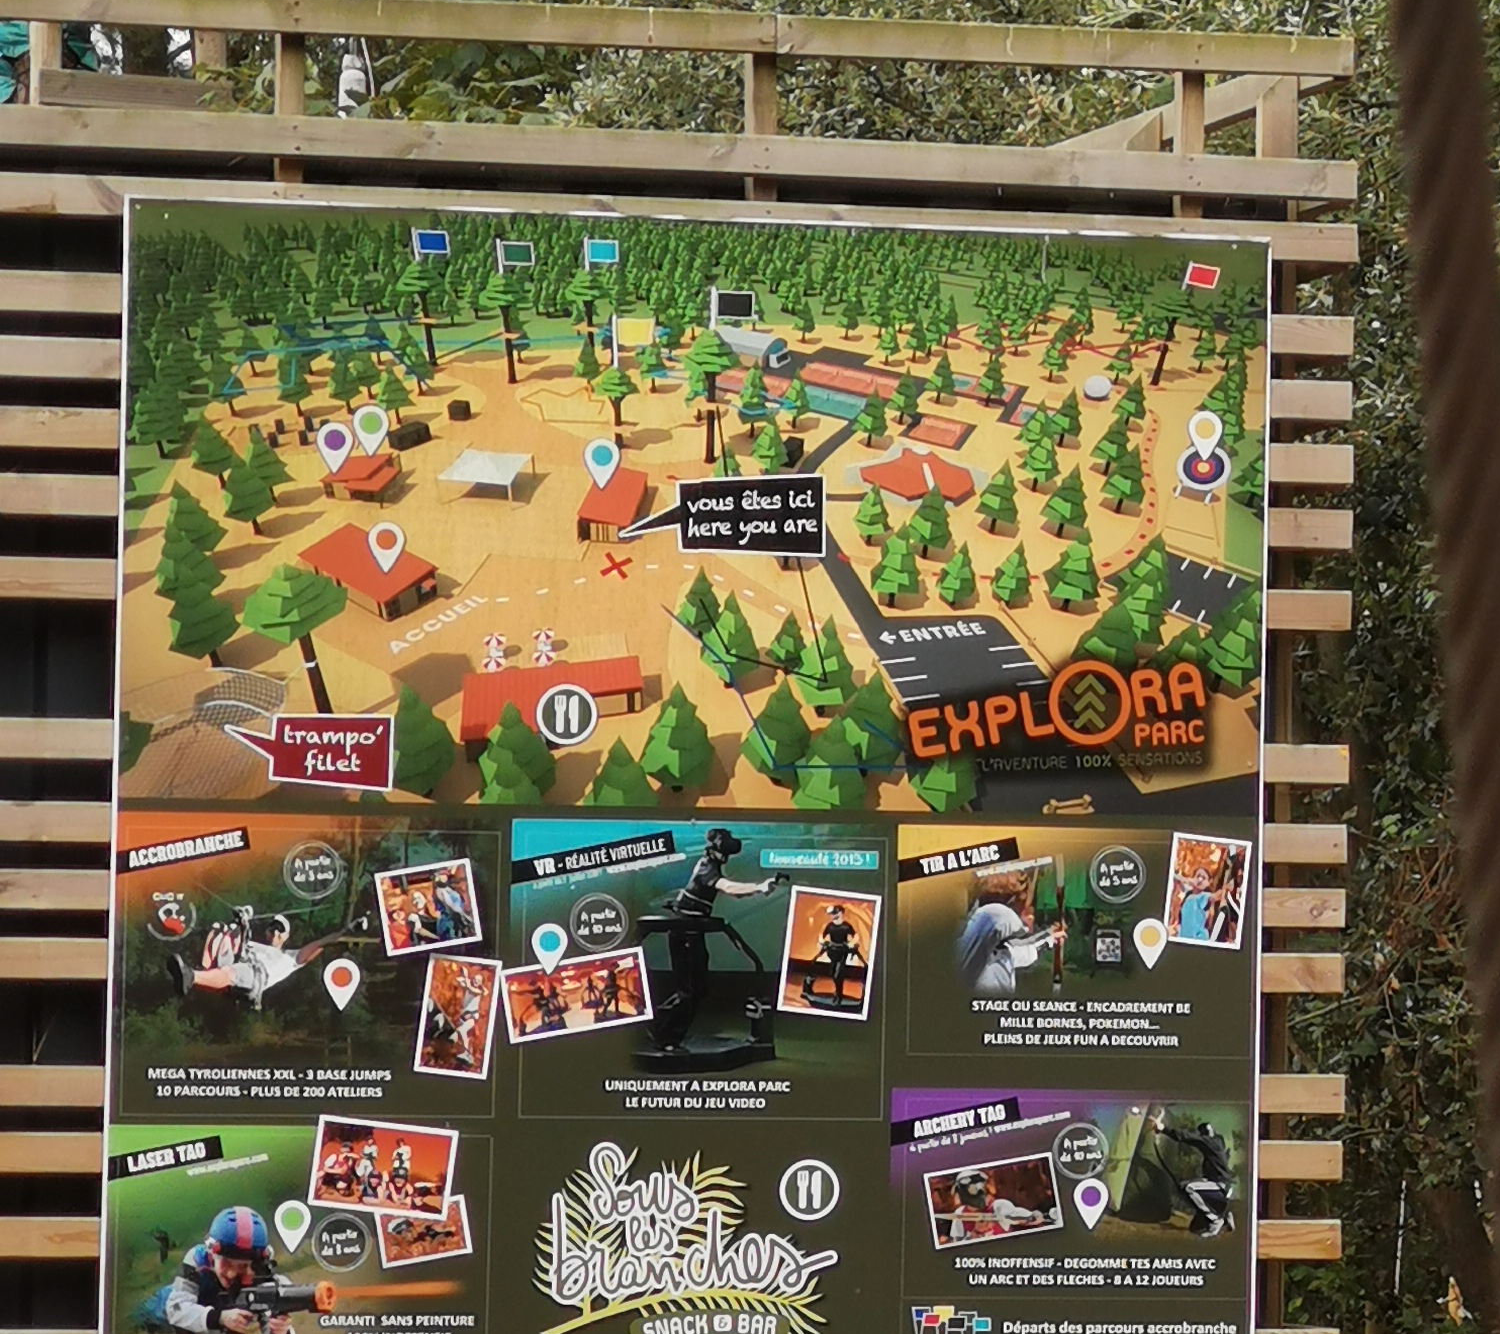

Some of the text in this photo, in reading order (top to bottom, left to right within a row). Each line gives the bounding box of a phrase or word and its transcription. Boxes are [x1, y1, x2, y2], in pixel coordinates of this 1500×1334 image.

[687, 488, 815, 512] vous êtes ici
[687, 516, 818, 546] here you are
[388, 594, 489, 655] ACCUEIL
[899, 620, 987, 644] ENTRÉE
[284, 724, 384, 756] trampo'
[1134, 719, 1205, 748] PARC
[304, 748, 361, 775] filet
[1074, 754, 1112, 769] 100%
[1118, 752, 1203, 766] SENSATIONS
[129, 830, 244, 868] ACCROBRANCHE
[534, 858, 555, 876] VR
[565, 846, 609, 870] RÉALITÉ
[611, 838, 666, 861] VIRTUELLE
[919, 858, 945, 875] TIR
[948, 853, 959, 869] A
[963, 845, 1000, 867] L'ARC
[972, 1000, 1009, 1012] STAGE
[1012, 1000, 1030, 1012] OU
[1033, 1000, 1077, 1012] SEANCE
[1087, 1001, 1172, 1014] ENCADREMENT
[1000, 1017, 1086, 1030] MILLE BORNES,
[984, 1033, 1178, 1046] PLEINS DE JEUX FUN A DECOUVRIR
[148, 1068, 391, 1081] MEGA TYROLIENNES XXL BASE JUMPS
[157, 1085, 382, 1098] 10 PARCOURS PLUS DE 200 ATELIERS
[605, 1080, 687, 1094] UNIQUEMENT
[702, 1080, 756, 1092] EXPLORA
[759, 1081, 790, 1092] PARC
[625, 1097, 765, 1109] LE FUTUR DU JEU VIDEO
[913, 1111, 975, 1137] ARCHERY
[978, 1105, 1006, 1125] TAG
[127, 1148, 176, 1172] LASER
[179, 1142, 206, 1161] TAG
[589, 1141, 699, 1223] Sous
[626, 1213, 678, 1255] les
[552, 1193, 838, 1305] branches
[955, 1258, 1216, 1270] 100% INOFFENSIF DEGOMME TES AMIS AVEC
[969, 1274, 1203, 1286] UN ARC ET DES FLECHES A 12 JOUEURS
[320, 1315, 475, 1327] GARANTI SANS PEINTURE
[1003, 1322, 1056, 1334] Départs
[1059, 1322, 1083, 1334] des
[1147, 1322, 1237, 1334] accrobranche
